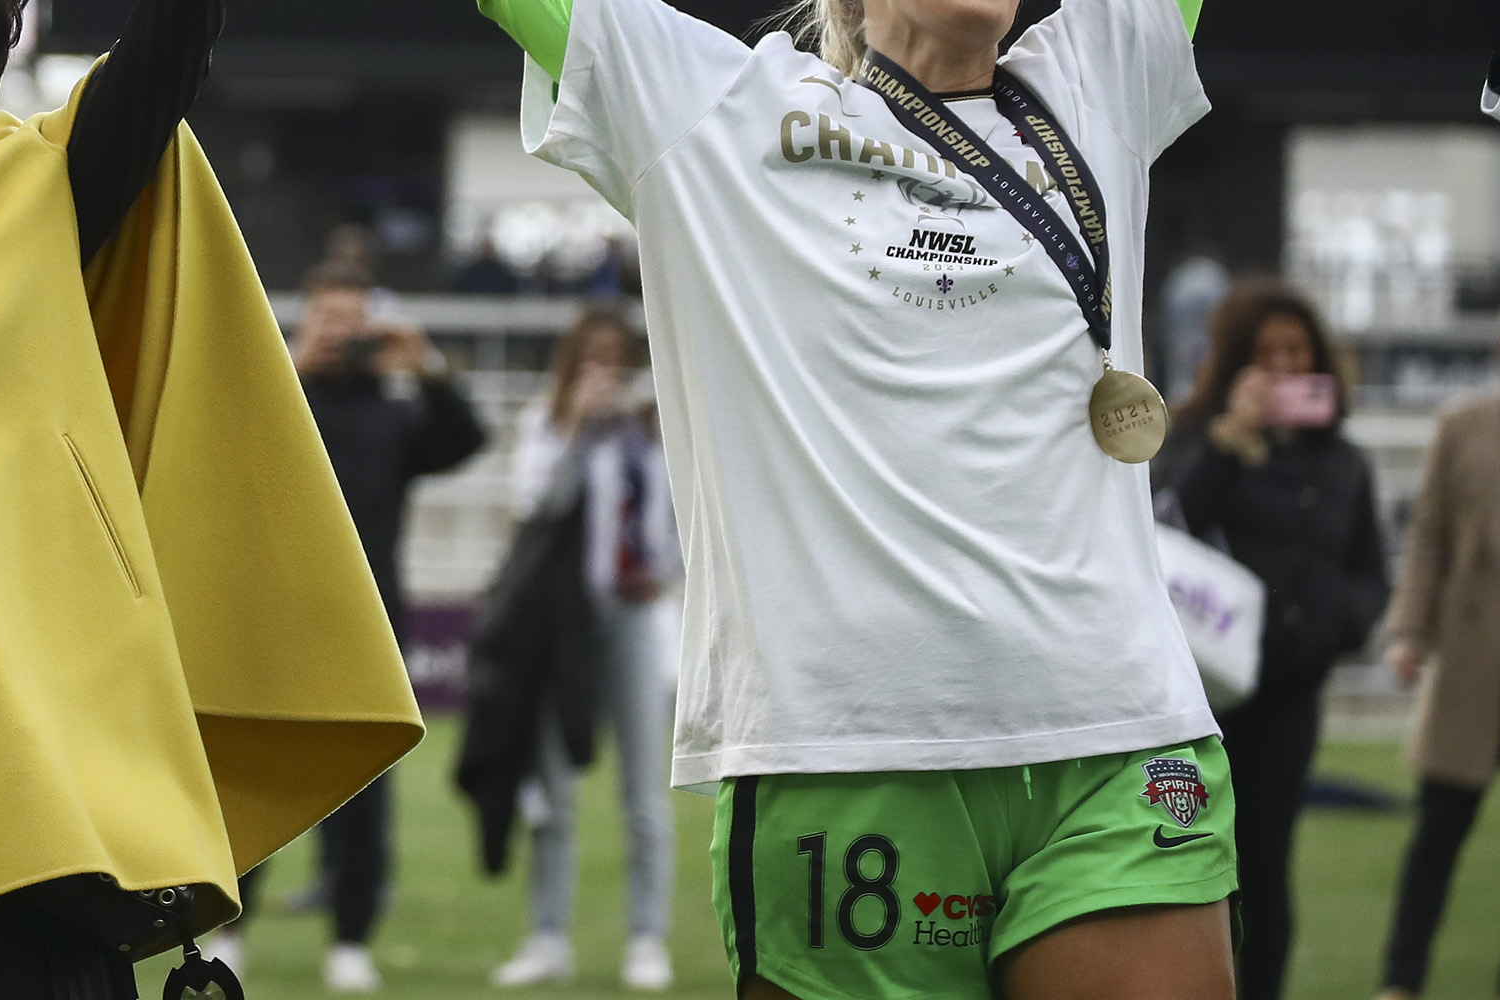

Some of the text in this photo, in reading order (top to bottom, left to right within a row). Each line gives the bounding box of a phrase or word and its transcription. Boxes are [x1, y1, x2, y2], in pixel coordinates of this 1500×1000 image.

[867, 65, 991, 168] CHAMPIONSHIP
[992, 173, 1066, 251] LOUISVILLE
[1077, 274, 1098, 311] 2021
[1025, 114, 1106, 250] HAMPIONSHIP
[908, 228, 977, 255] NWSL
[886, 246, 998, 266] CHAMPIONSHIP
[923, 263, 965, 271] 2021
[892, 282, 998, 310] LOUISVILLE
[1100, 399, 1150, 428] 2021
[1155, 780, 1198, 792] SPIRIT
[797, 831, 901, 951] 18
[943, 894, 996, 920] CVS
[913, 920, 985, 948] Health
